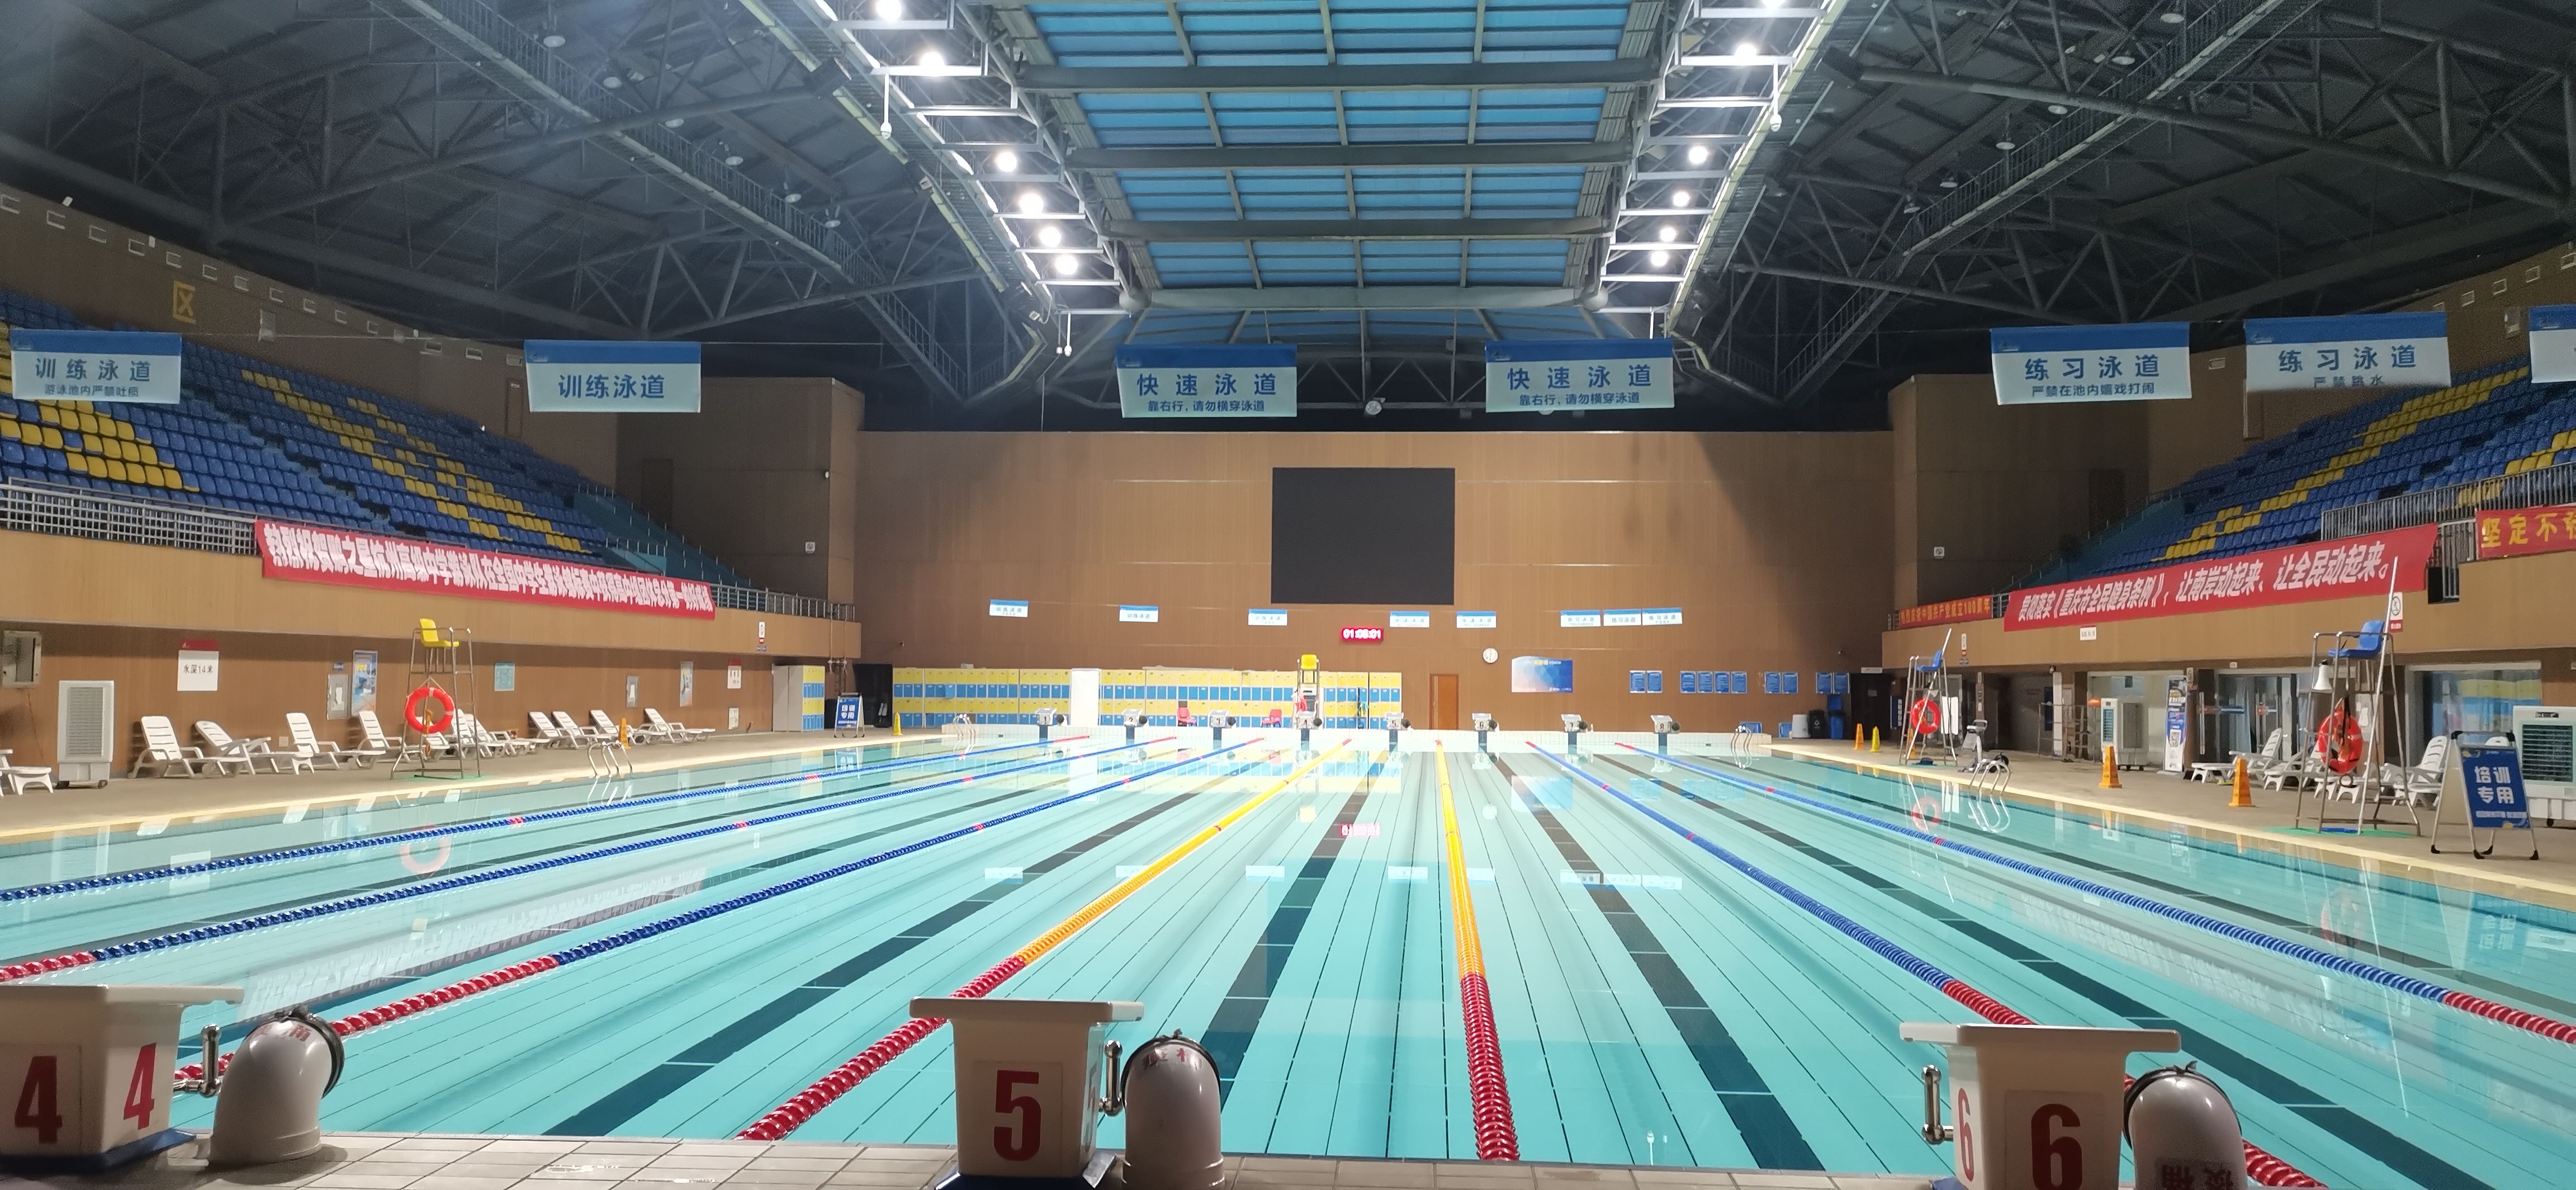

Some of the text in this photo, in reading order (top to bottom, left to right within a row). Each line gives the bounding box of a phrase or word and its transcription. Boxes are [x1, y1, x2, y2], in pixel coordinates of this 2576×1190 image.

[172, 280, 196, 324] 区
[35, 357, 150, 382] 训练泳道
[2025, 354, 2160, 381] 练习泳道
[2279, 344, 2416, 373] 练习泳道
[45, 384, 139, 397] 游泳池内严禁吐痰
[558, 374, 665, 399] 训练泳道
[1137, 373, 1276, 396] 快速泳道
[1507, 364, 1651, 390] 快速泳道
[2474, 766, 2511, 784] 培训
[2477, 786, 2515, 804] 专用
[123, 1042, 157, 1130] 4
[15, 1056, 63, 1144] 4
[993, 1069, 1041, 1162] 5
[1958, 1087, 1974, 1182] 6
[2031, 1103, 2083, 1190] 6
